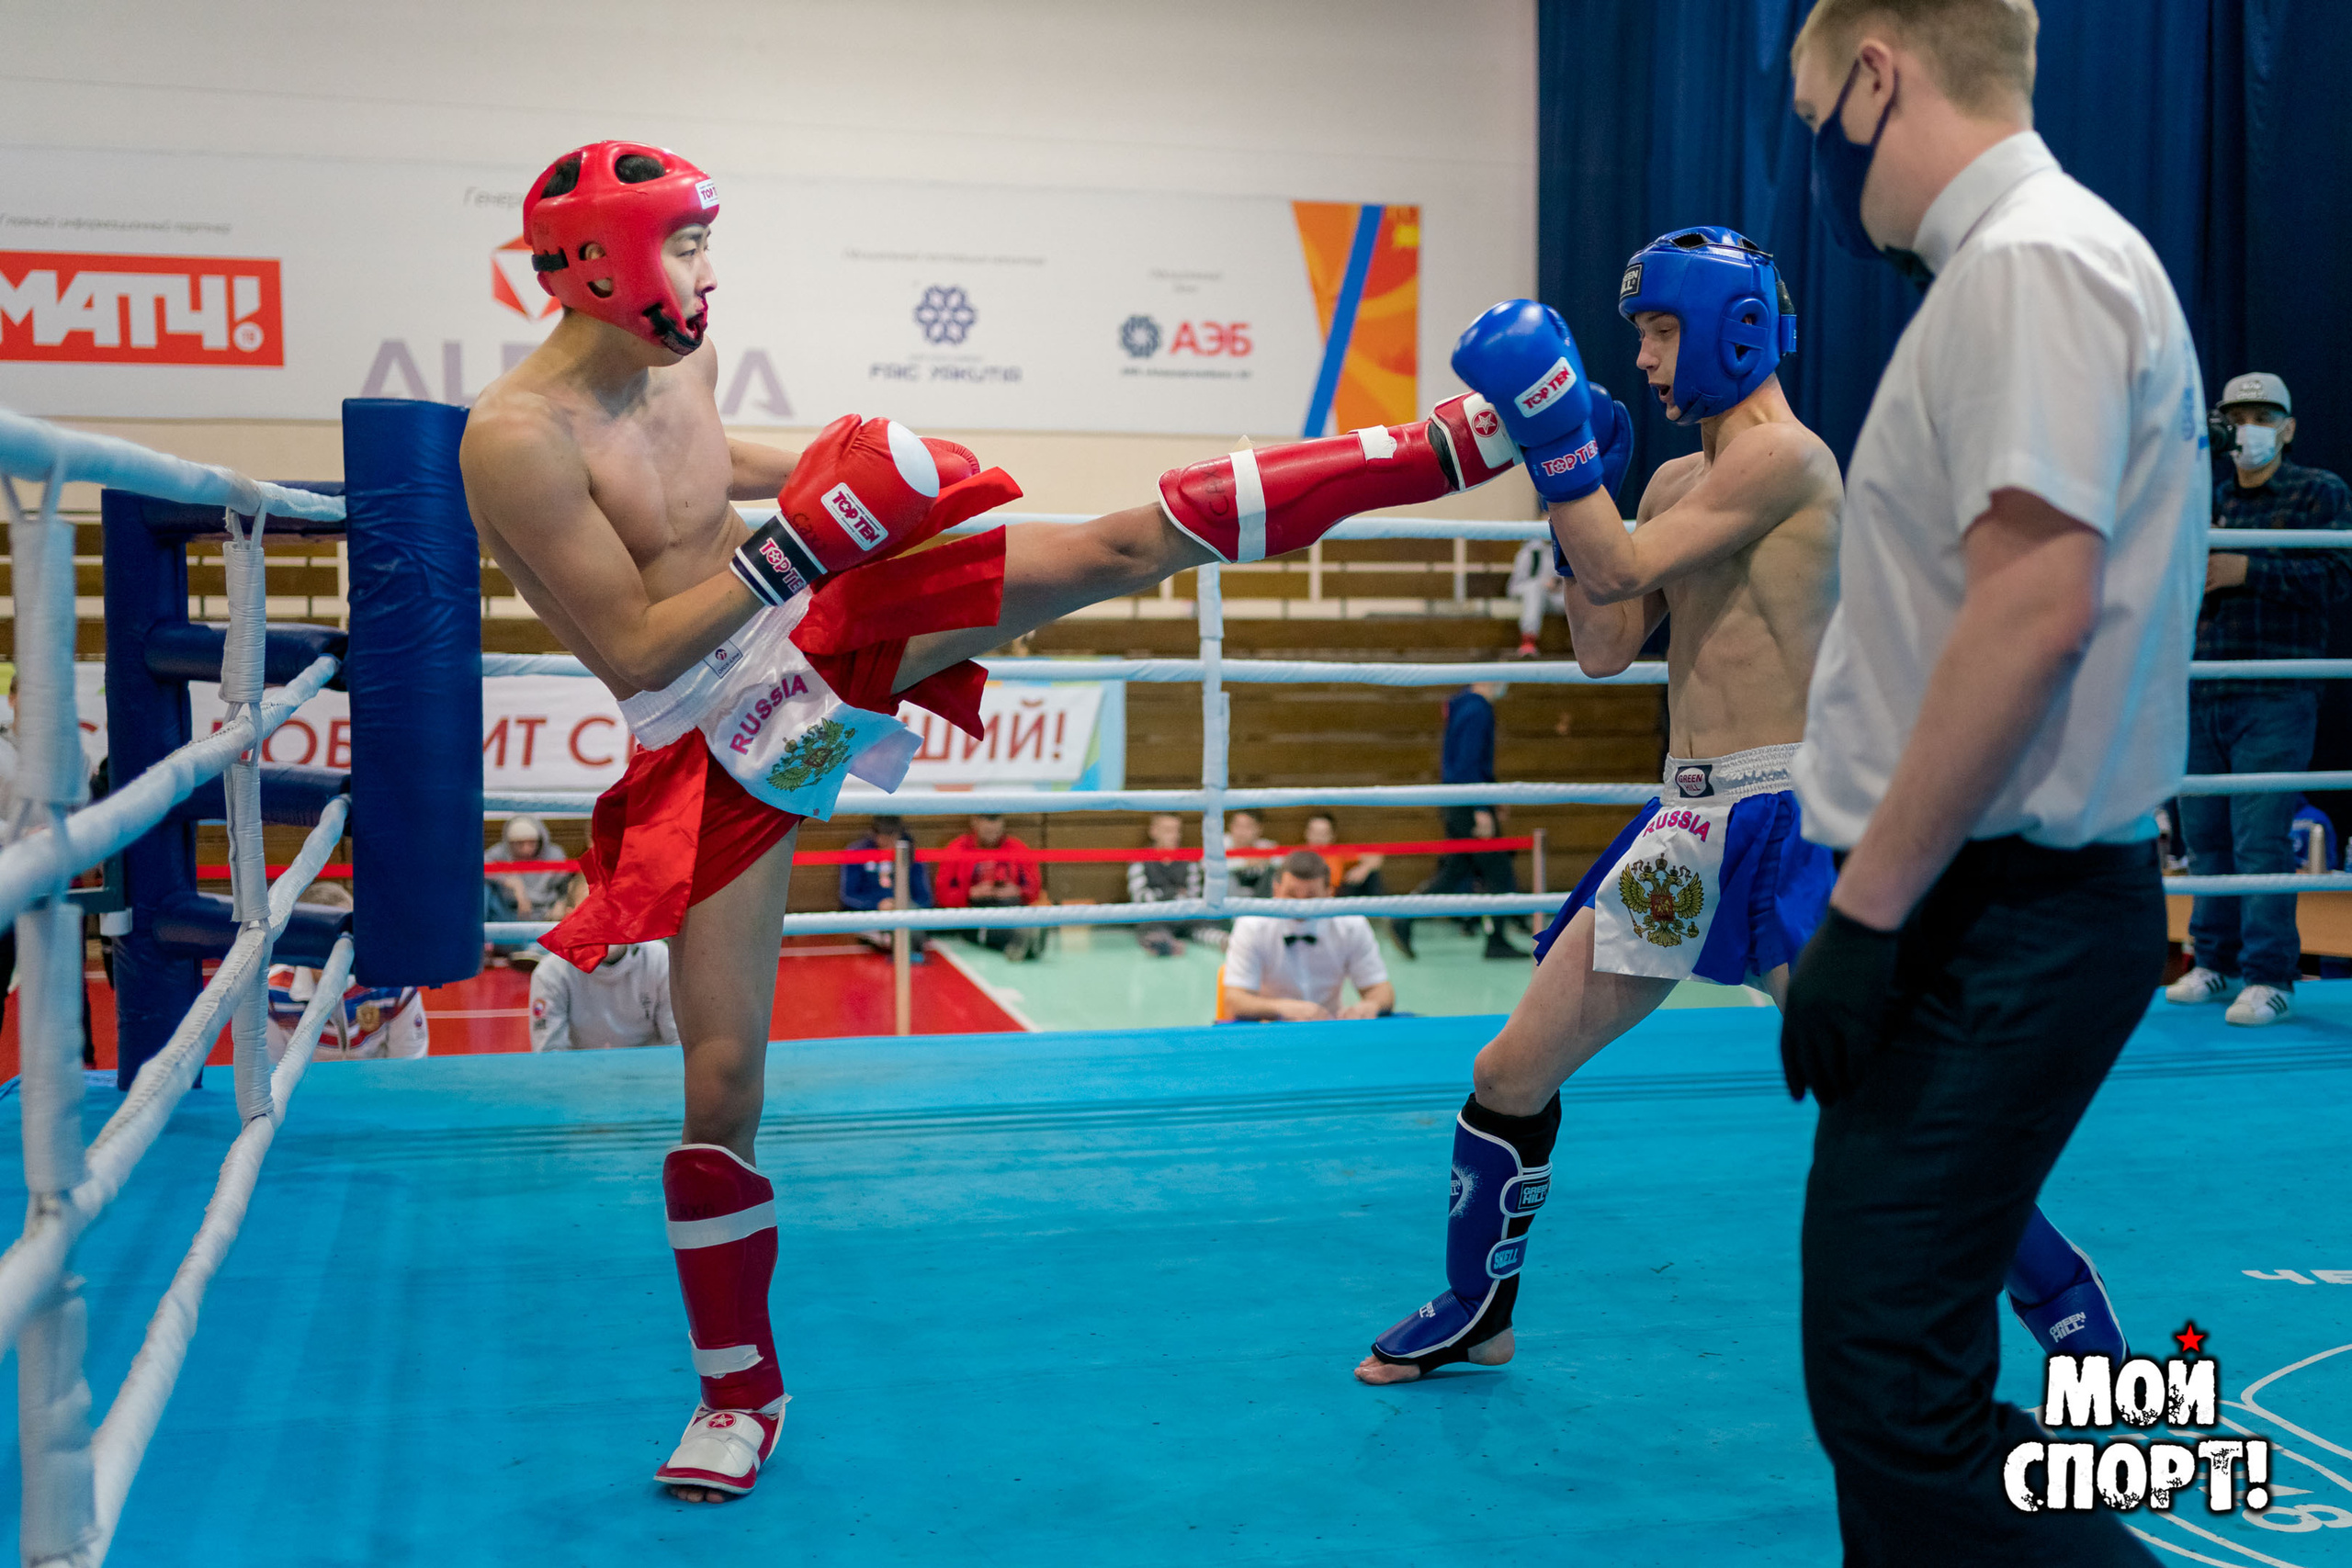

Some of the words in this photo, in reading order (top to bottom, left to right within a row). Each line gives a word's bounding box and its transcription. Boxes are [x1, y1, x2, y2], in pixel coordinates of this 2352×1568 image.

[0, 270, 262, 351] МАТЧ!
[1522, 387, 1549, 409] TOP
[1548, 367, 1570, 391] TEN
[1541, 454, 1577, 477] TOP
[832, 491, 859, 519] TOP
[854, 516, 880, 544] TEN
[759, 536, 792, 572] TOP
[783, 567, 808, 593] TE
[729, 674, 808, 755] RUSSIA
[1678, 773, 1703, 783] GREEN
[1684, 784, 1702, 792] HILL
[1643, 810, 1711, 842] RUSSIA
[1522, 1191, 1546, 1204] HILL
[1494, 1248, 1519, 1269] SHELL
[2050, 1312, 2086, 1336] GREEN
[2053, 1322, 2085, 1342] HILL
